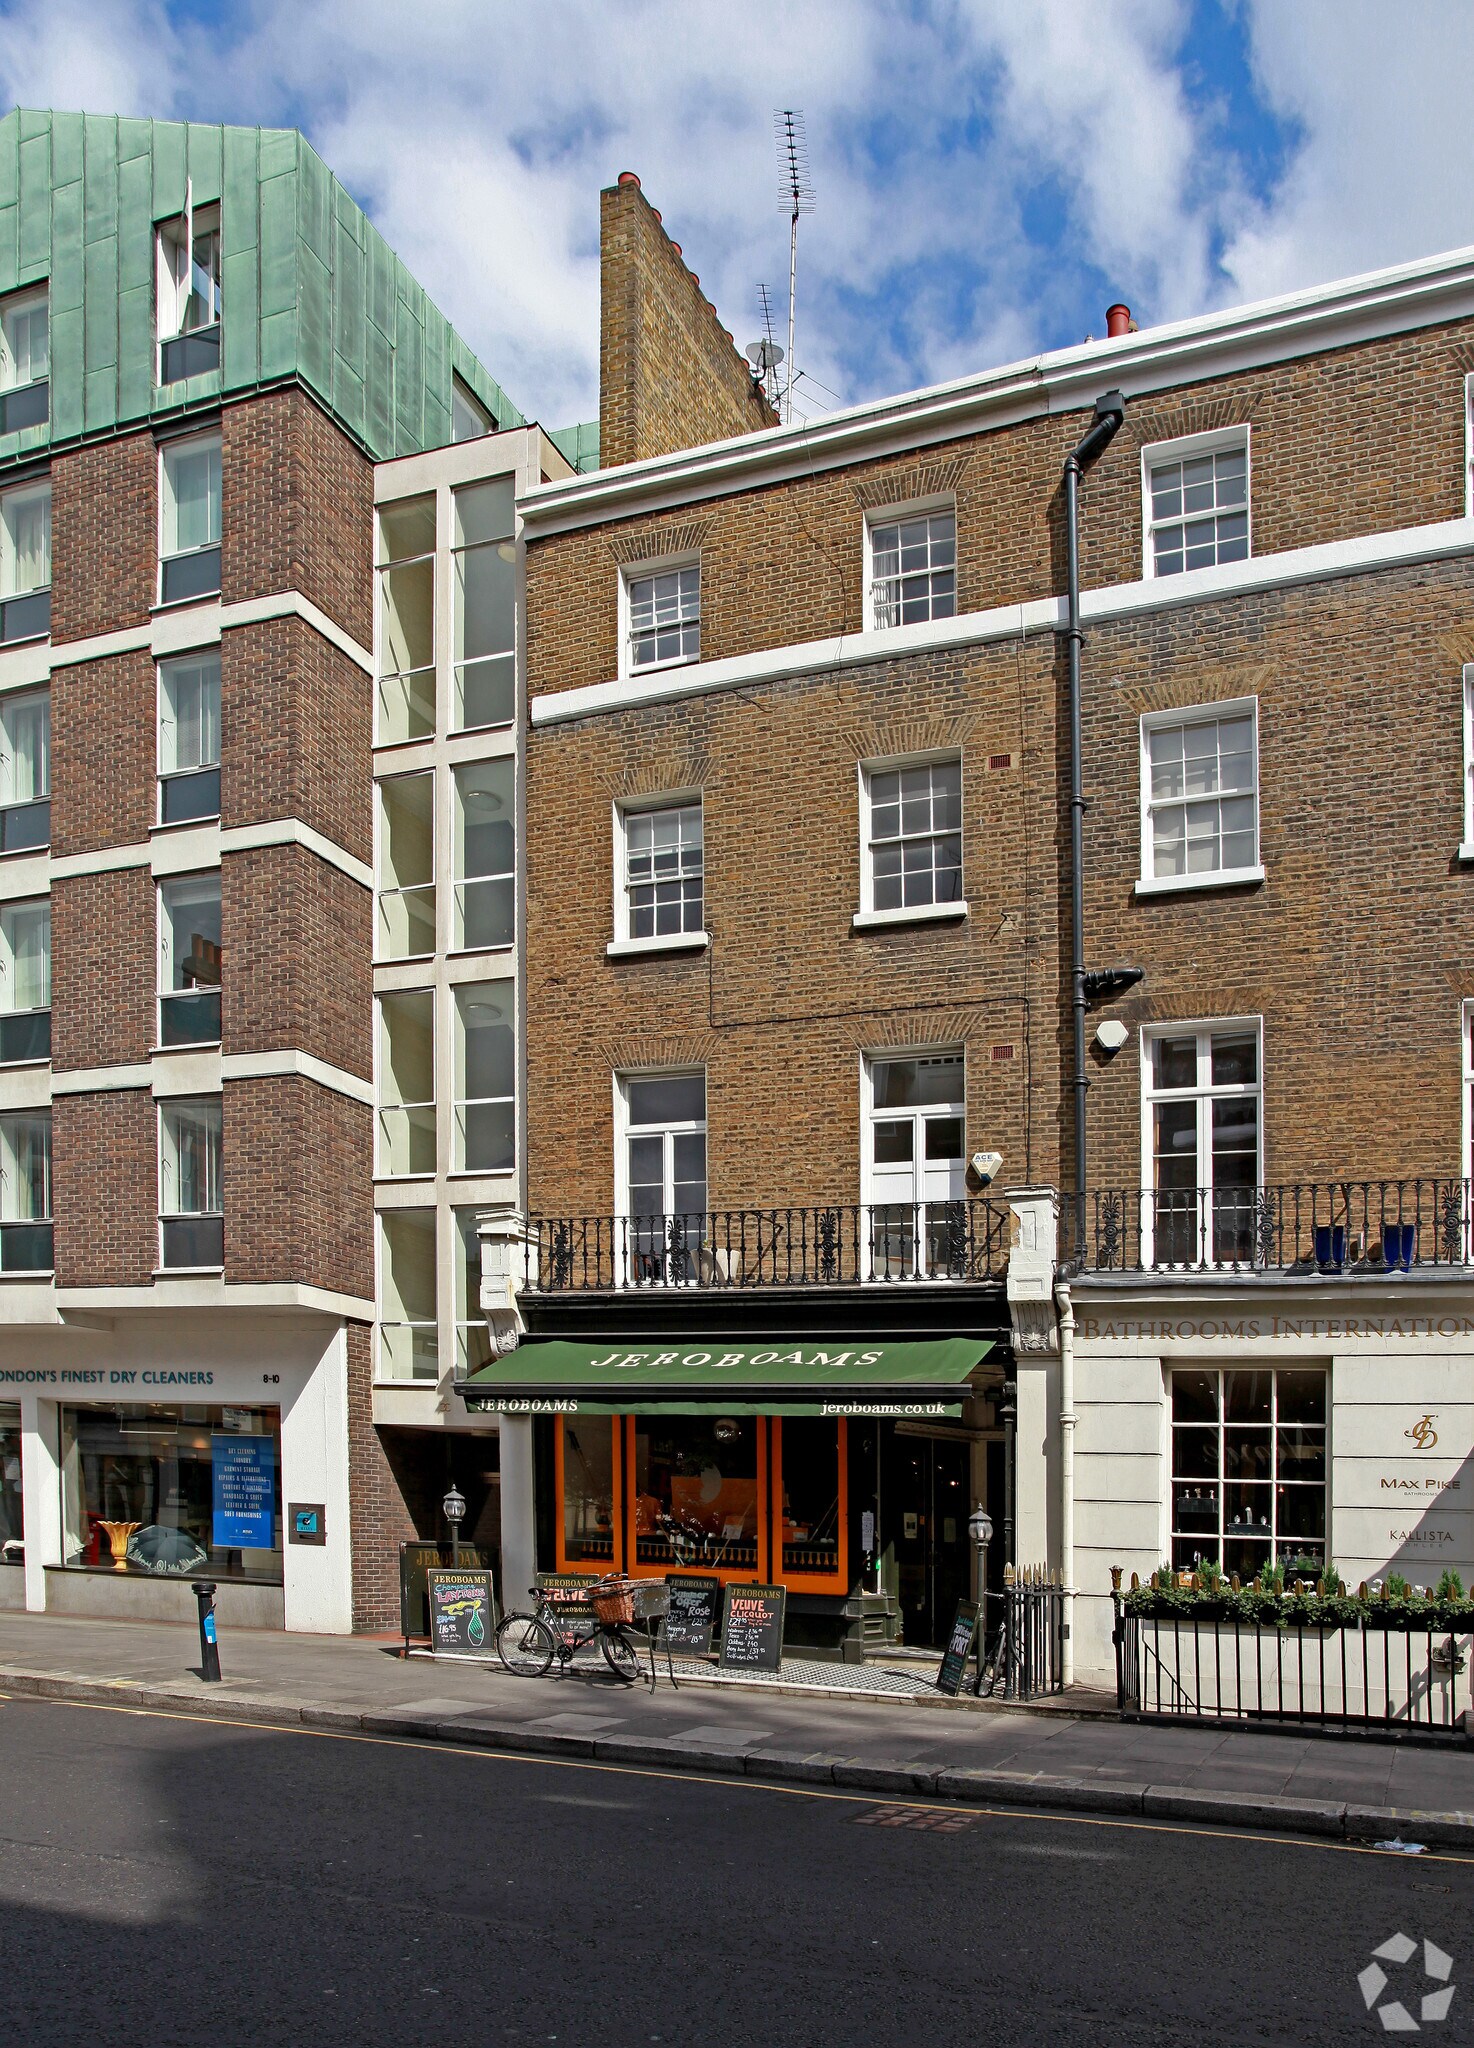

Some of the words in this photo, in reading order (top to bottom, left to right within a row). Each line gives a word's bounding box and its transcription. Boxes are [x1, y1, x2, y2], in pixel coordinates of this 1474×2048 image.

[1082, 1317, 1260, 1341] BATHROOMS
[590, 1351, 884, 1367] JEROBOAMS
[61, 1370, 105, 1384] FINEST
[110, 1371, 137, 1384] DRY
[142, 1371, 214, 1385] CLEANERS
[263, 1374, 280, 1384] 8-10
[477, 1399, 578, 1412] JEROBOAMS
[820, 1401, 946, 1416] jeroboams.co.uk
[1380, 1479, 1420, 1489] MAX
[1425, 1480, 1461, 1490] PIKE
[1389, 1530, 1455, 1542] KALLISTA
[434, 1575, 487, 1584] JEROBOAMS
[670, 1579, 714, 1589] JEROBOAMS
[731, 1588, 780, 1599] JEROBOAMS
[731, 1599, 765, 1612] VEUVE
[730, 1610, 774, 1619] CLICQUOT
